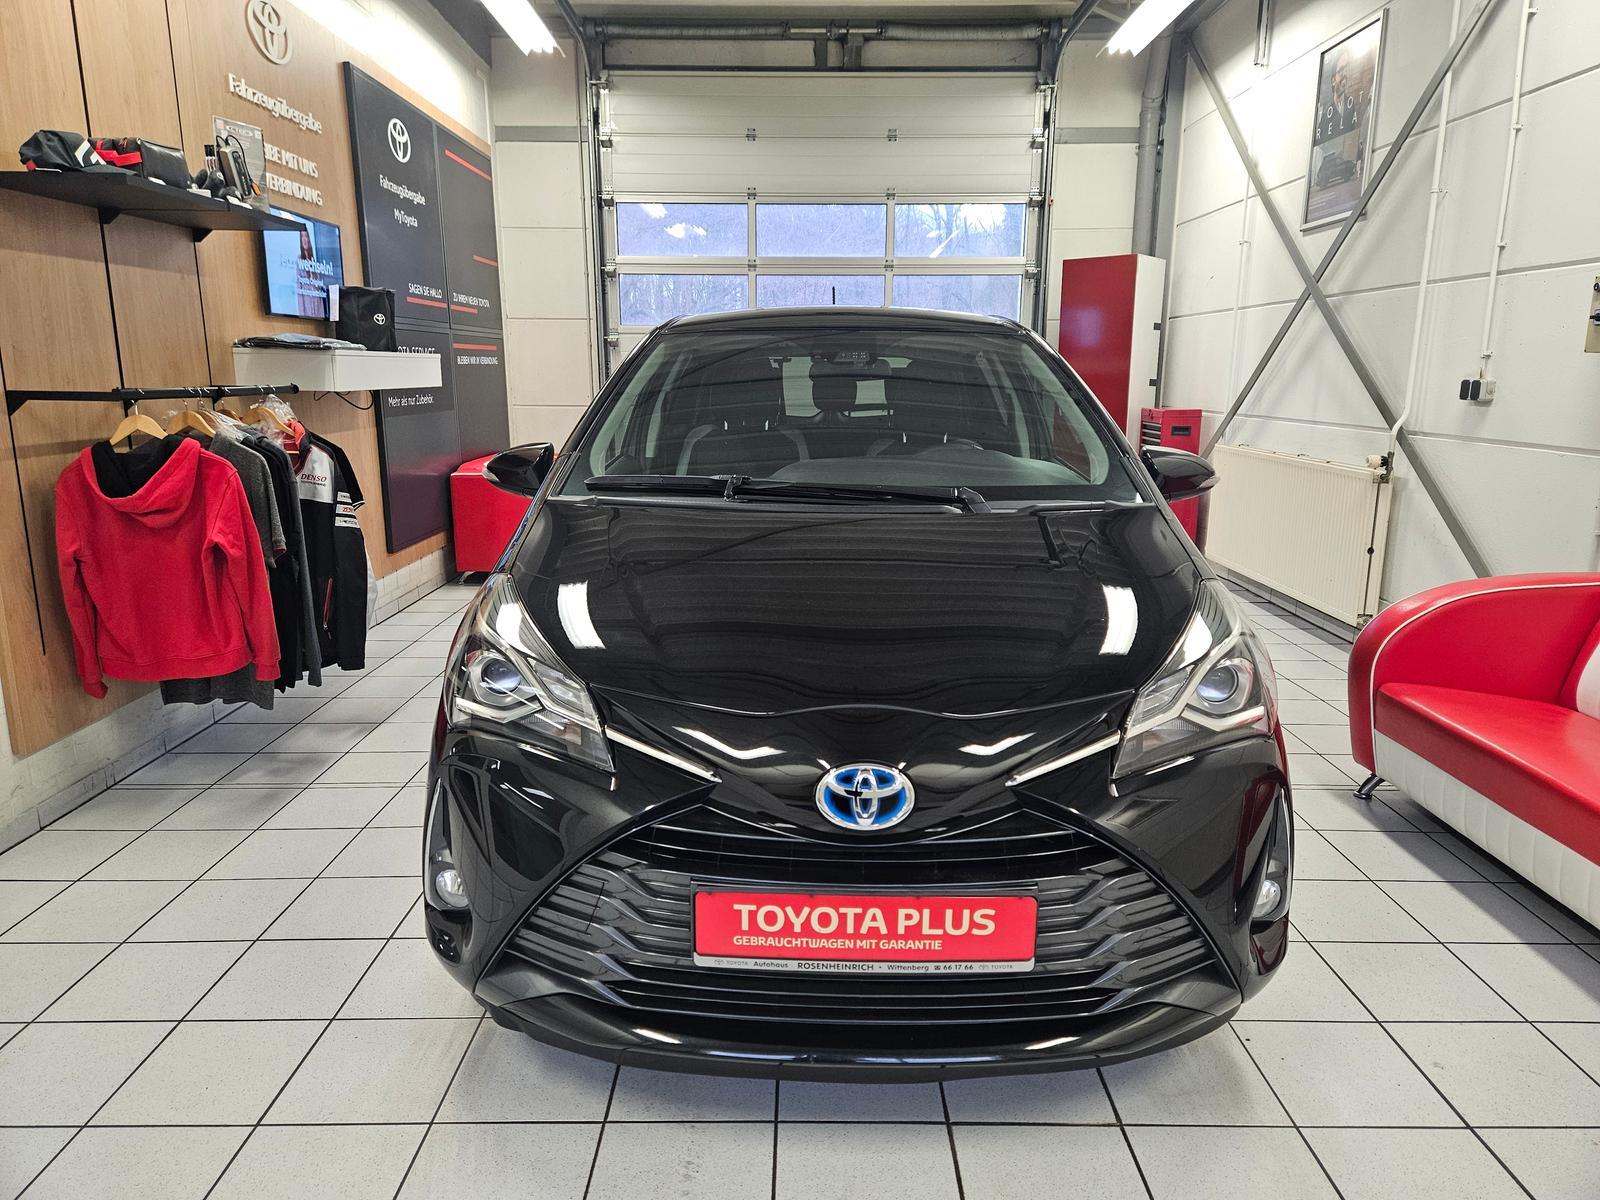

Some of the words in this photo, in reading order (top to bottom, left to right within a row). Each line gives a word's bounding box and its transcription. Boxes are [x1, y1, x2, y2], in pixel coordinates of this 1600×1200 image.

[228, 72, 323, 135] Fahrzeugübergabe
[281, 149, 298, 170] MIT
[298, 156, 319, 178] UNS
[379, 174, 426, 205] Fahrzeugübergabe
[393, 208, 418, 228] MyToyota
[408, 283, 423, 295] SAGEN
[430, 287, 443, 299] HALLO
[388, 396, 400, 407] Mehr
[301, 473, 327, 483] DENSO
[733, 904, 888, 934] TOYOTA
[897, 908, 996, 936] PLUS
[733, 935, 854, 949] GEBRAUCHTWAGEN
[856, 939, 878, 950] MIT
[879, 939, 942, 950] GARANTIE
[797, 962, 874, 971] ROSENHEINRICH
[887, 964, 929, 972] Wittenberg
